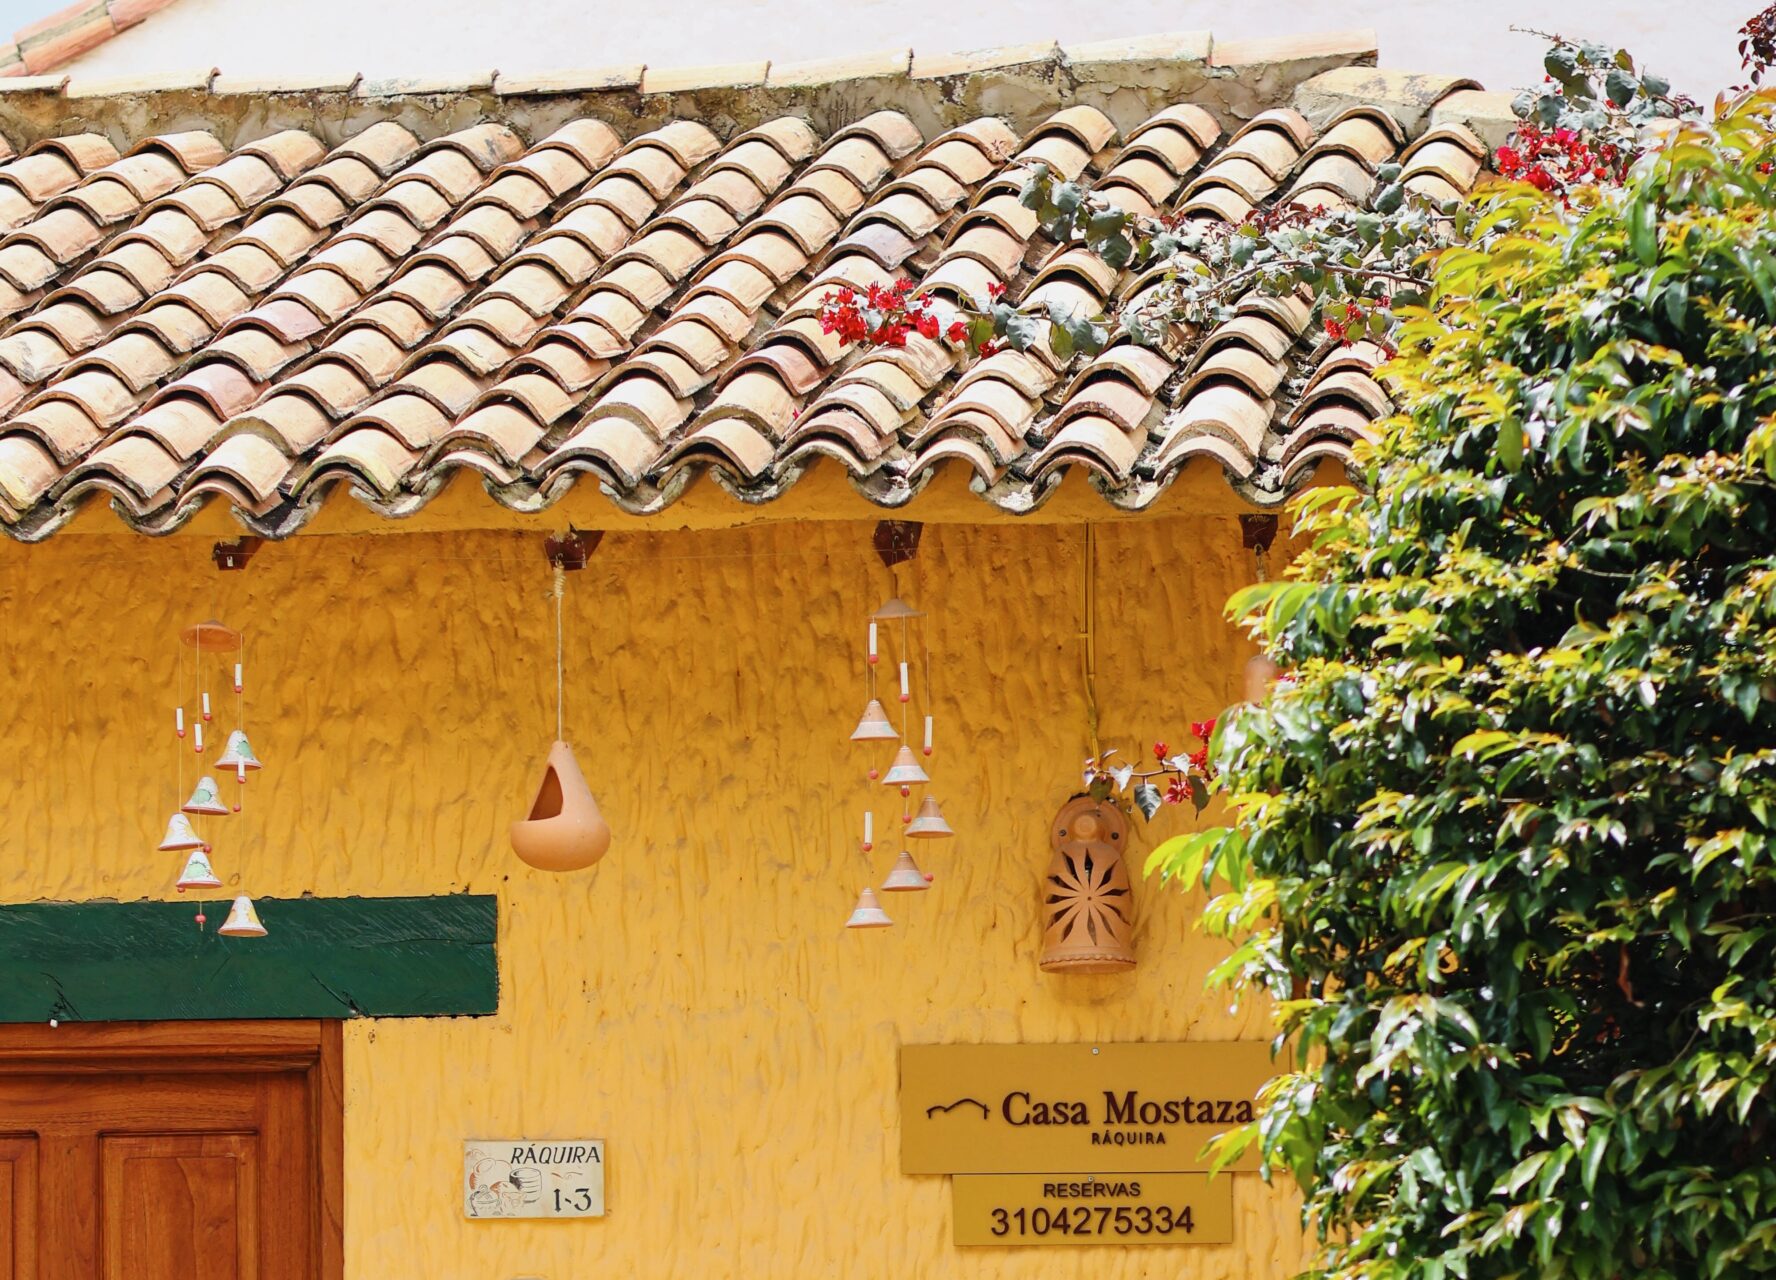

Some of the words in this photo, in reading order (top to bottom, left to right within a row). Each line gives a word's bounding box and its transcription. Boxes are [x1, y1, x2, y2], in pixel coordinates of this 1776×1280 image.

[1002, 1091, 1089, 1126] Casa
[1103, 1090, 1255, 1125] Mostaza
[1091, 1130, 1166, 1147] RÁQUIRA
[510, 1143, 601, 1165] RÁQUIRA
[553, 1188, 592, 1213] 1-3
[1043, 1182, 1141, 1198] RESERVAS
[991, 1206, 1194, 1236] 3104275334
